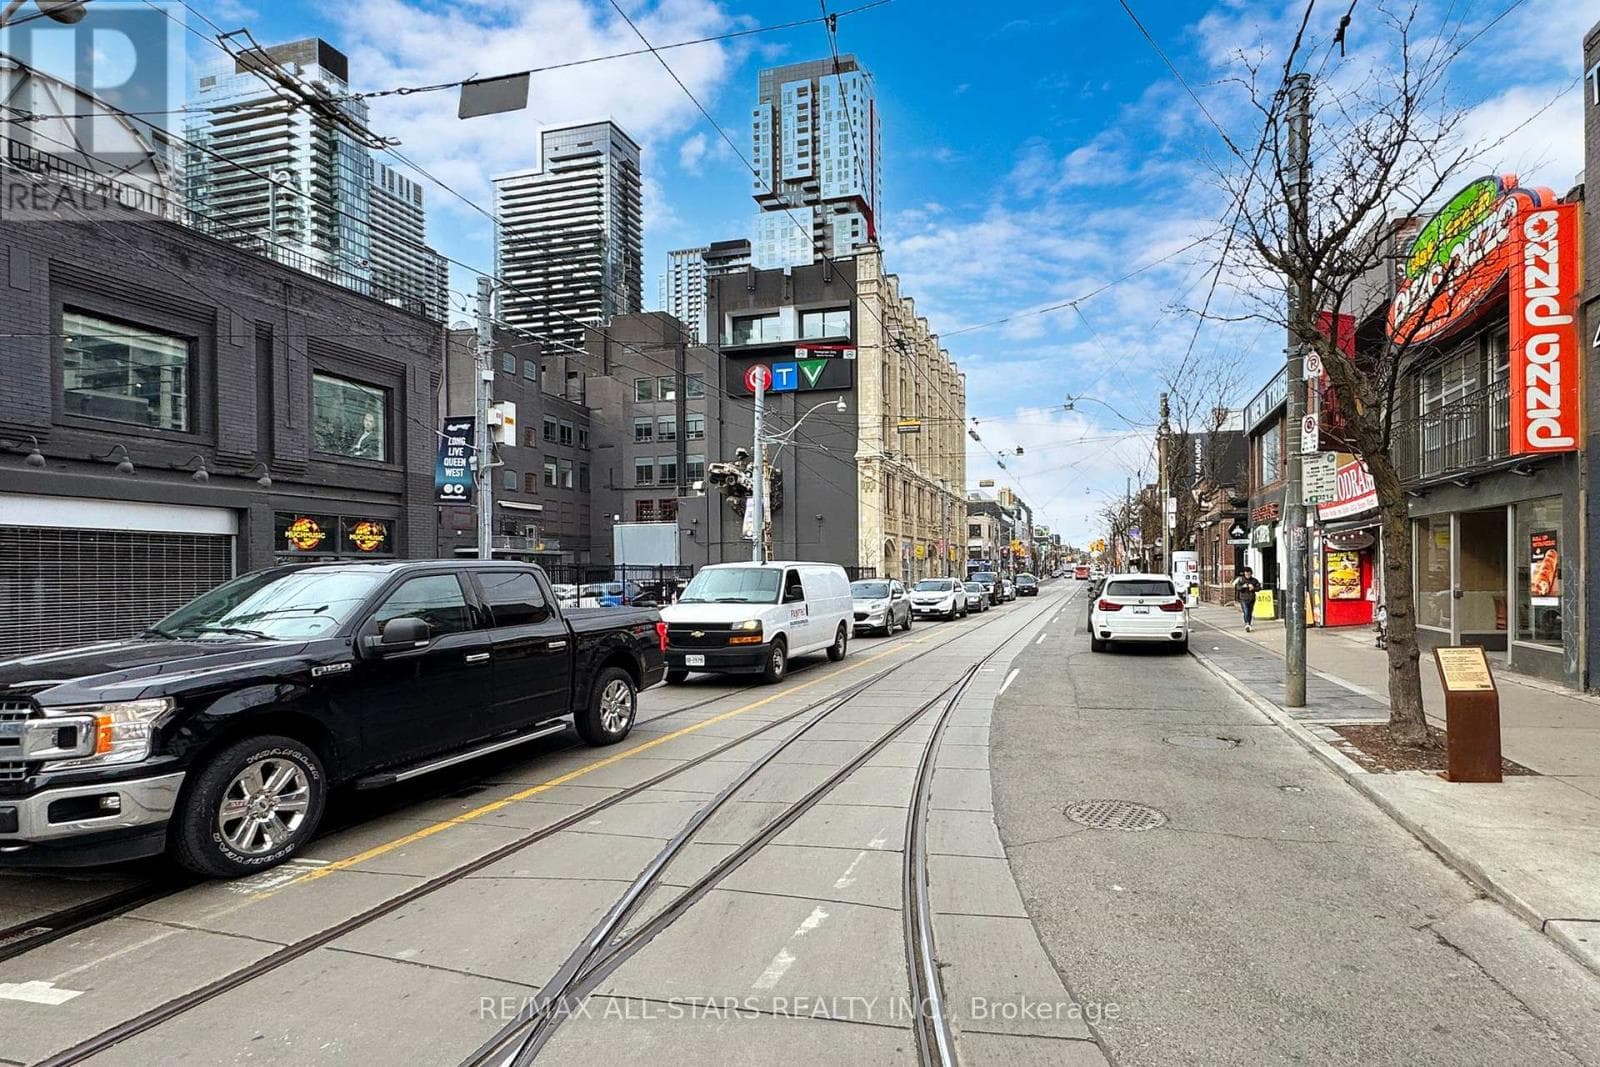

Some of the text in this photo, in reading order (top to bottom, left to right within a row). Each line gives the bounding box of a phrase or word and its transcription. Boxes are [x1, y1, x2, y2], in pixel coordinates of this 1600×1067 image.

[448, 436, 466, 446] LONG
[448, 448, 464, 456] LIVE
[444, 458, 466, 466] QUEEN
[445, 468, 464, 477] WEST
[284, 531, 326, 540] MUCHMUSIC
